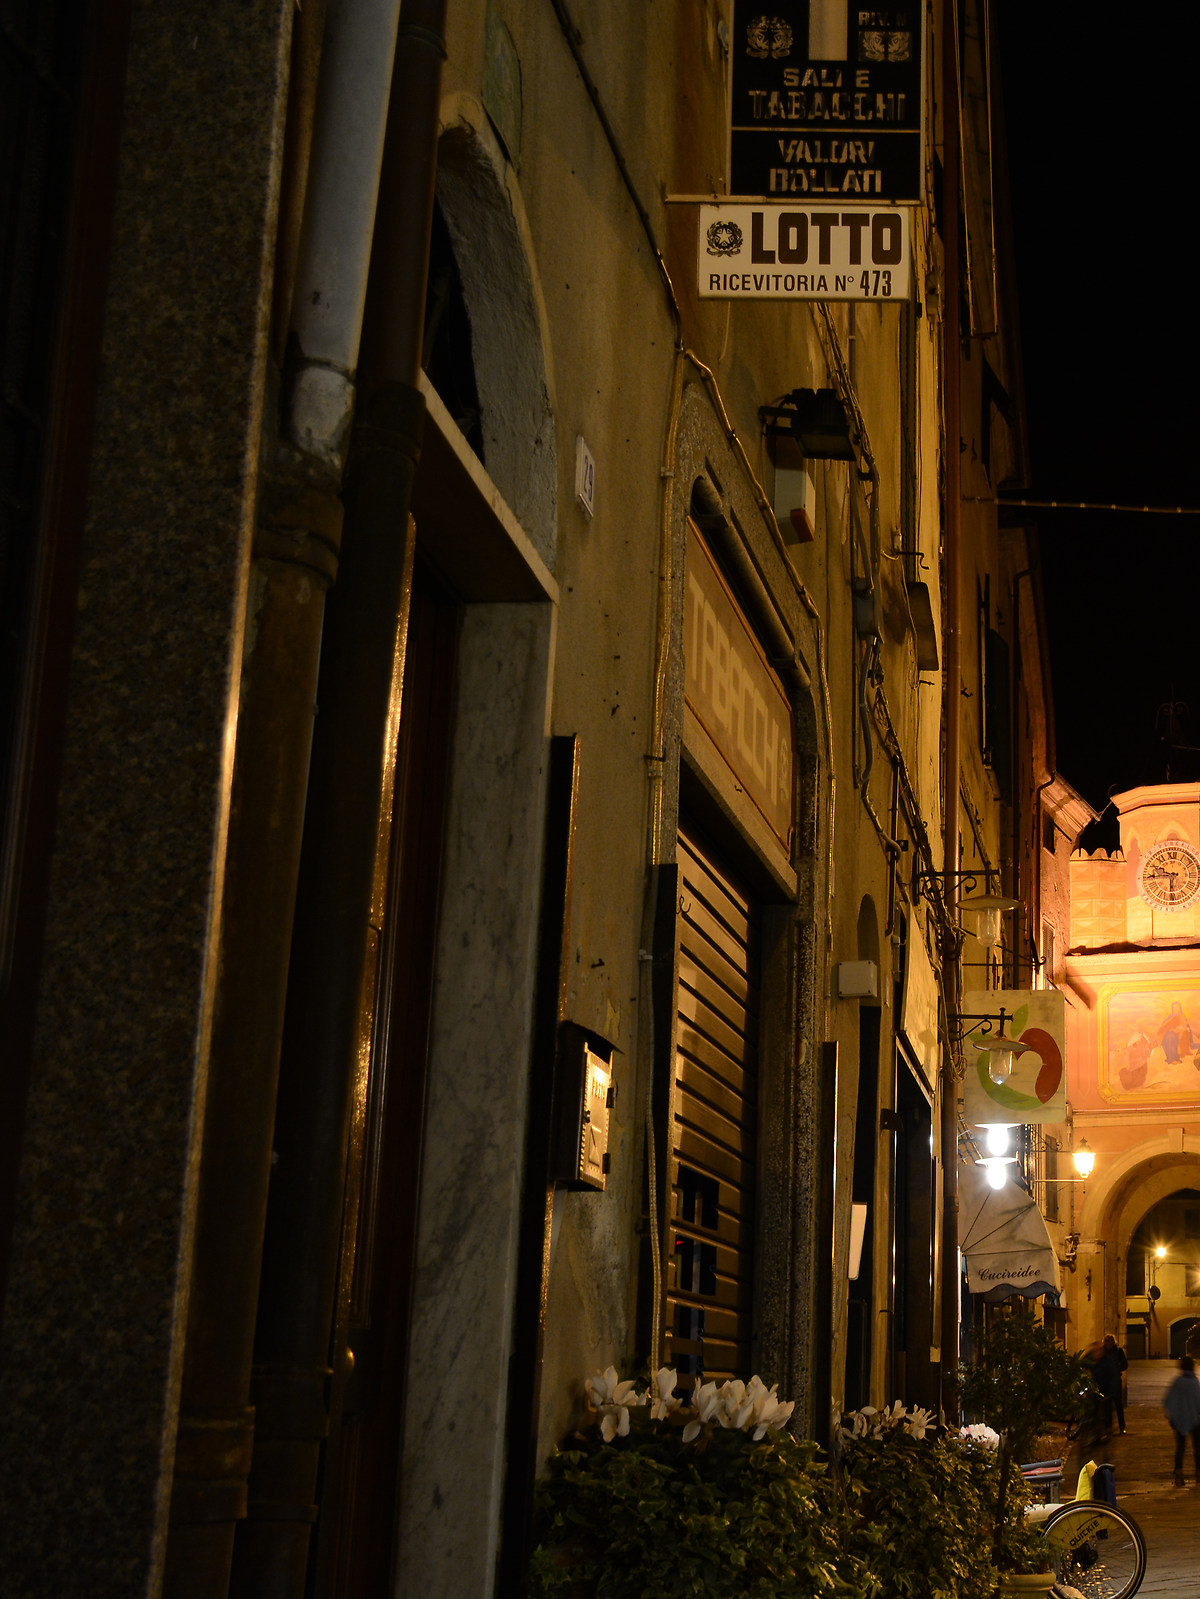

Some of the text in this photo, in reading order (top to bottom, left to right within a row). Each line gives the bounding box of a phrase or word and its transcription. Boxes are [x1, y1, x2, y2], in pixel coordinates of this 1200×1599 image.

[783, 67, 870, 88] SALI E
[751, 212, 902, 265] LOTTO
[709, 274, 828, 292] RICEVITORIA
[859, 270, 892, 297] 473
[979, 1265, 1041, 1281] Cucireidee
[1069, 1519, 1101, 1548] QUICKIE
